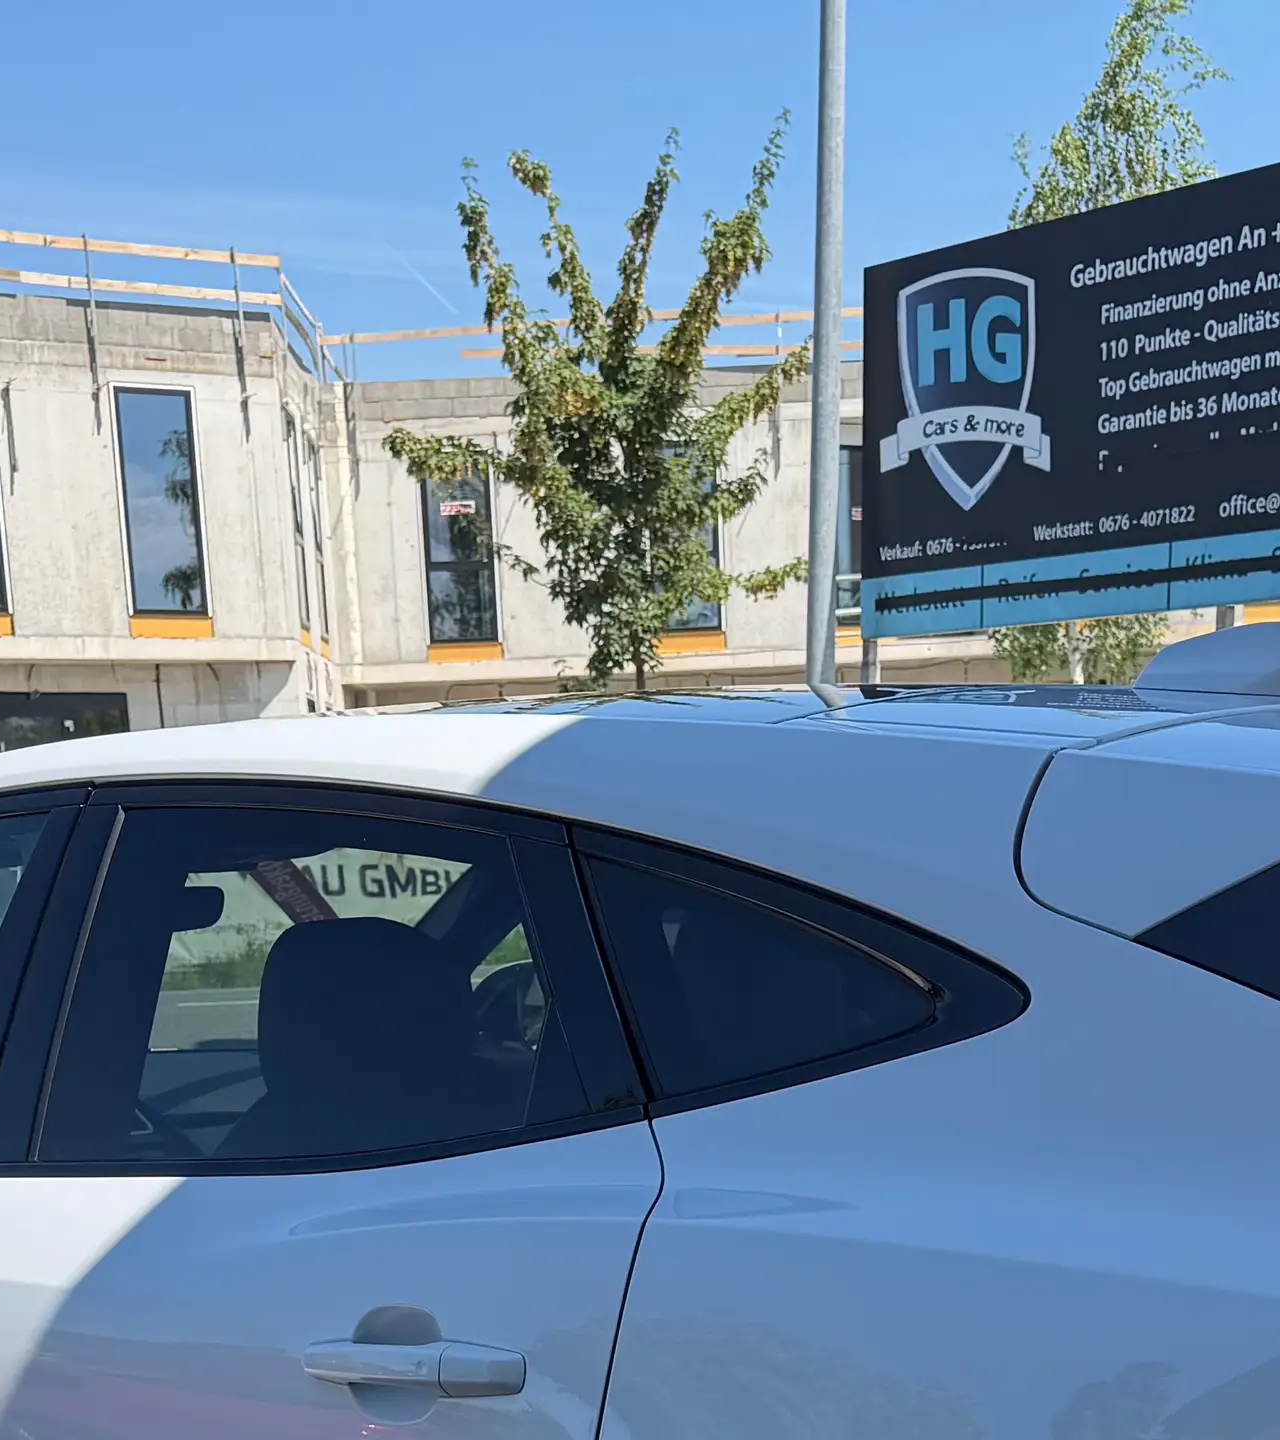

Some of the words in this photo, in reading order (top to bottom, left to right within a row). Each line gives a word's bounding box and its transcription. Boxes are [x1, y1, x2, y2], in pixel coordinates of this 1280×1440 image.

[1070, 234, 1233, 288] Gebrauchtwagen
[1237, 225, 1266, 251] An
[1101, 288, 1204, 325] Finanzierung
[1207, 279, 1251, 301] ohne
[917, 294, 1022, 388] HG
[1100, 337, 1128, 361] 110
[1134, 328, 1190, 354] Punkte
[1099, 377, 1126, 400] Top
[1129, 351, 1261, 393] Gebrauchtwagen
[923, 419, 958, 438] Cars
[964, 414, 980, 433] &
[984, 417, 1025, 437] more
[1097, 405, 1166, 434] Garantie
[1170, 402, 1194, 423] bis
[1197, 396, 1218, 420] 36
[1033, 520, 1093, 541] Werkstatt:
[1098, 513, 1130, 533] 0676
[1140, 505, 1195, 527] 4071822
[880, 540, 923, 561] Verkauf:
[926, 537, 954, 556] 0676
